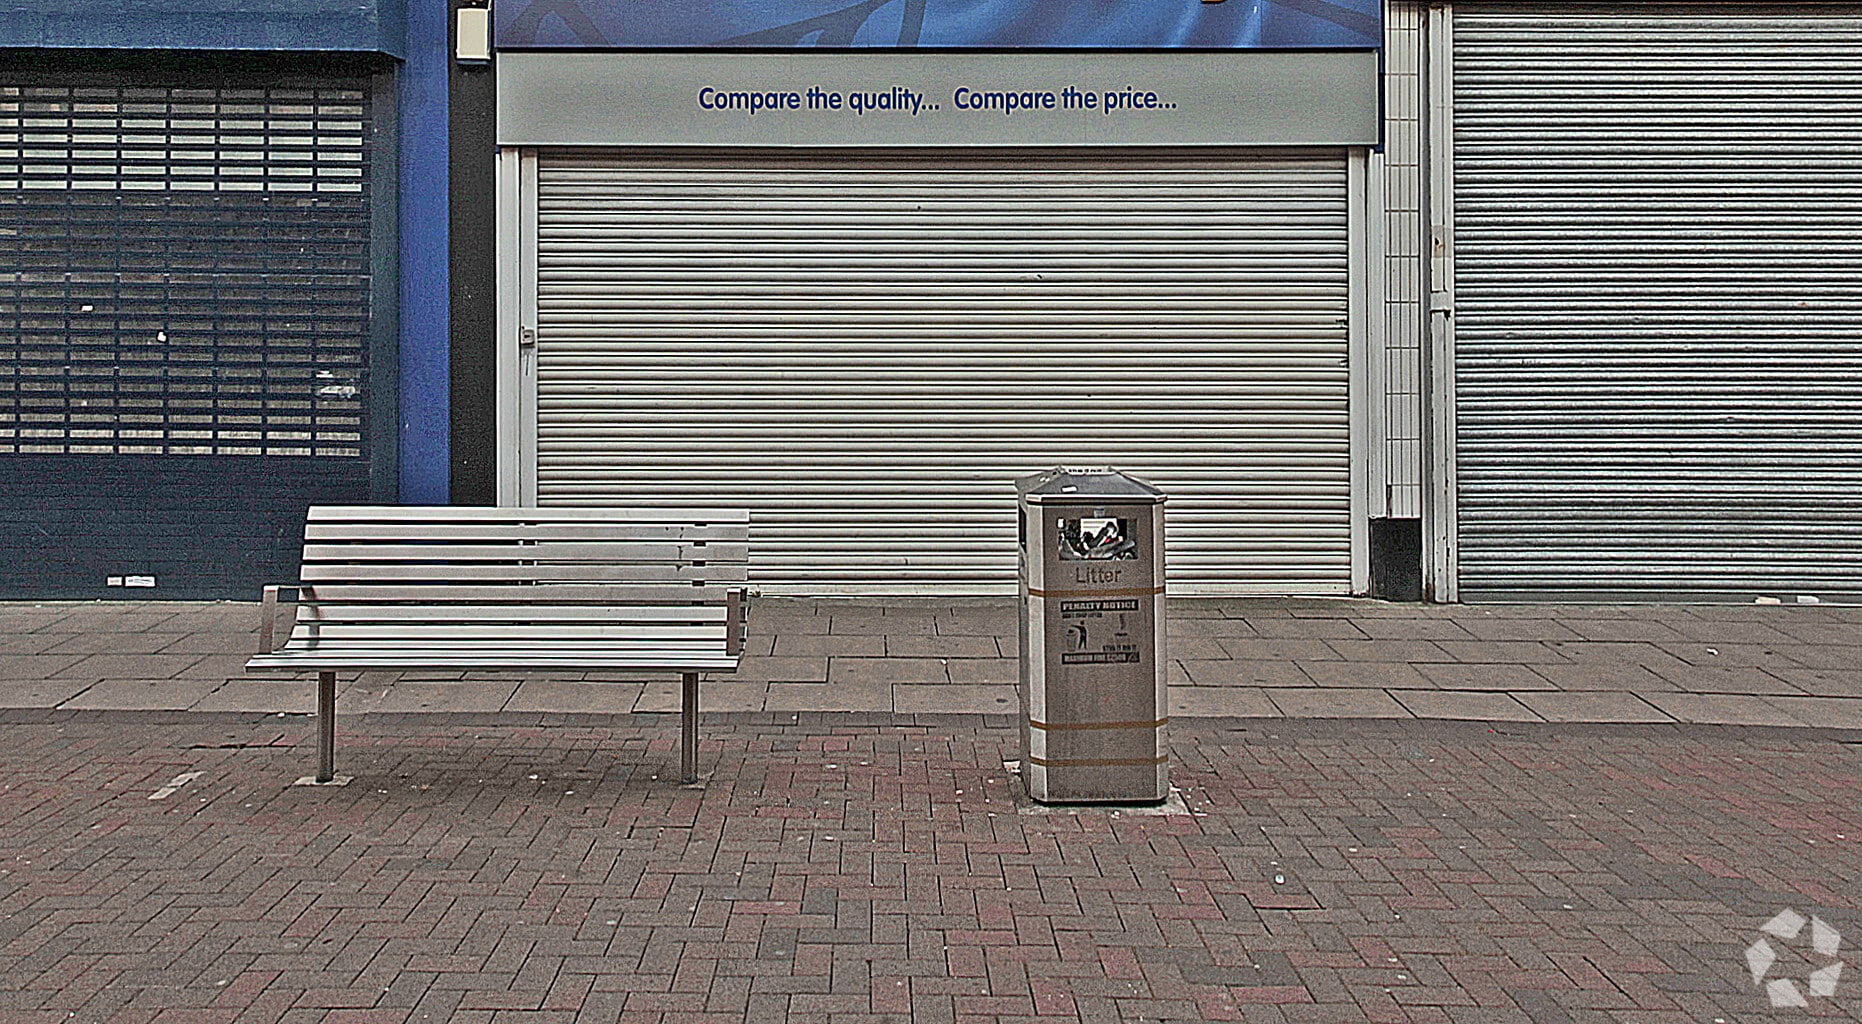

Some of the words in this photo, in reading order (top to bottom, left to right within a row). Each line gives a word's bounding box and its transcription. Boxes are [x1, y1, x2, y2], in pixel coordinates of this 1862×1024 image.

[698, 87, 801, 115] Compare
[806, 86, 842, 110] the
[848, 86, 940, 116] quality...
[954, 87, 1056, 116] Compare
[1061, 85, 1098, 109] the
[1104, 85, 1177, 115] price...
[1075, 566, 1122, 584] Litter
[1062, 602, 1101, 611] PENALTY
[1102, 601, 1136, 610] NOTICE
